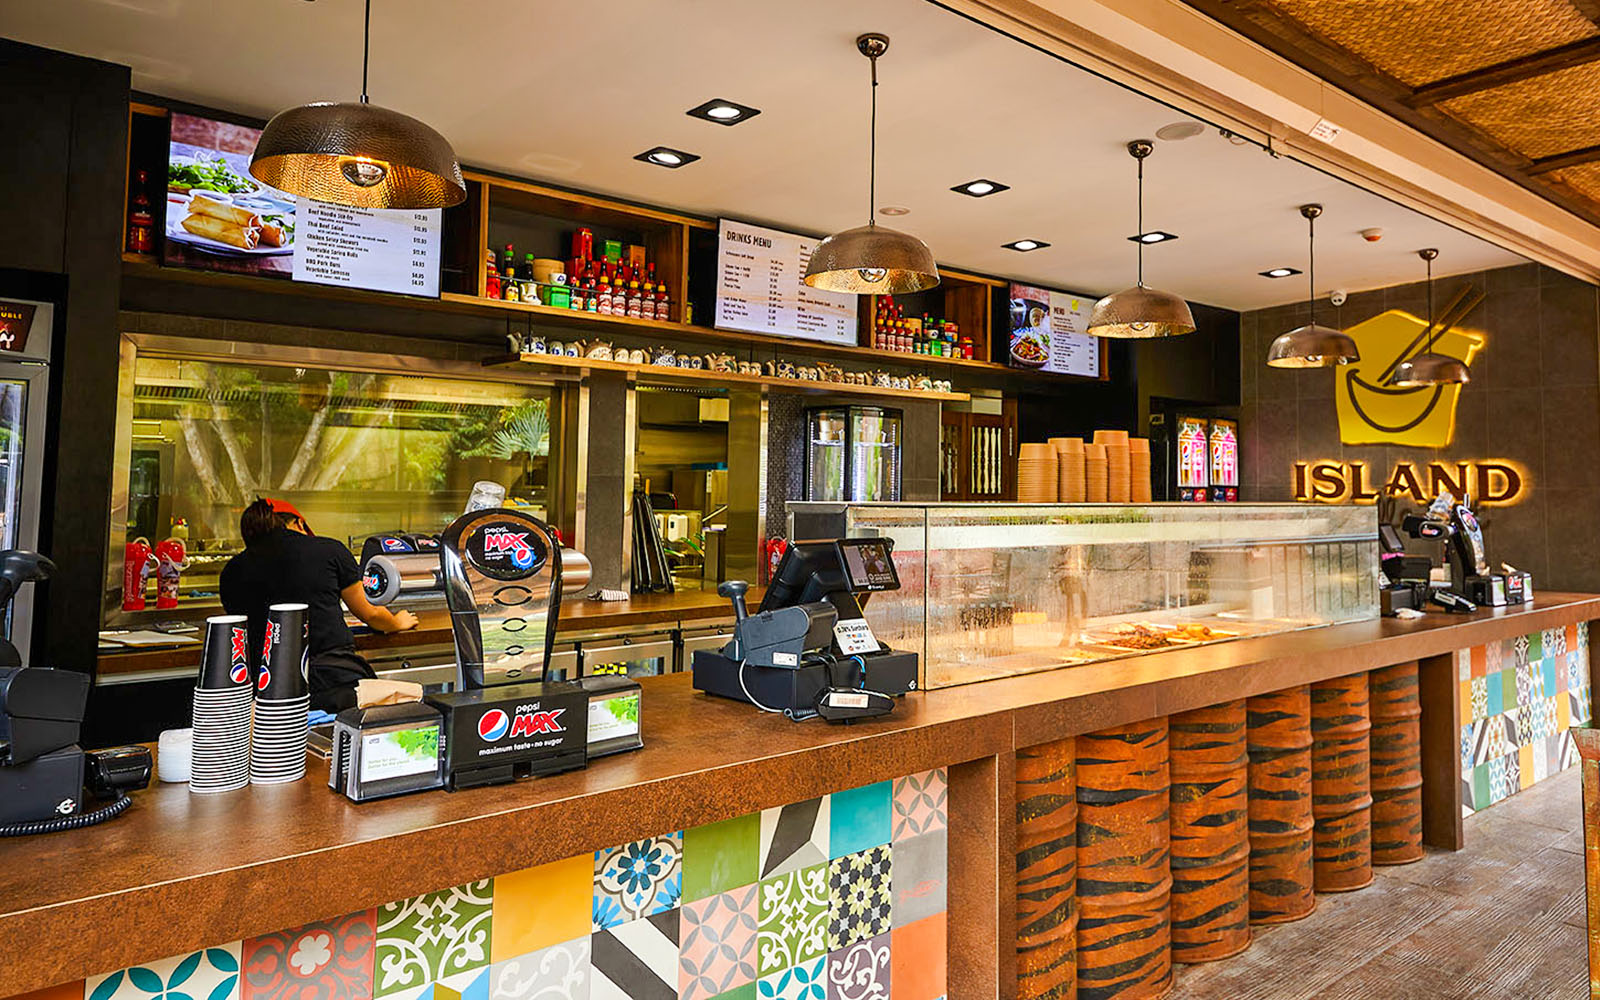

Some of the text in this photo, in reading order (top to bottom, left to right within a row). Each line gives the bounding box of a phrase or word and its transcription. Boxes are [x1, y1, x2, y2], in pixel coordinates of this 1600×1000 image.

[726, 231, 772, 248] DRINKS MENU
[1294, 463, 1522, 502] ISLAND
[484, 526, 508, 534] pepsi
[484, 532, 531, 552] MAX
[232, 627, 246, 664] MAX
[262, 619, 274, 666] MAX
[516, 702, 540, 714] pepsi
[509, 708, 566, 738] MAX
[478, 744, 512, 756] maximum
[514, 741, 531, 750] taste
[544, 738, 564, 746] sugar
